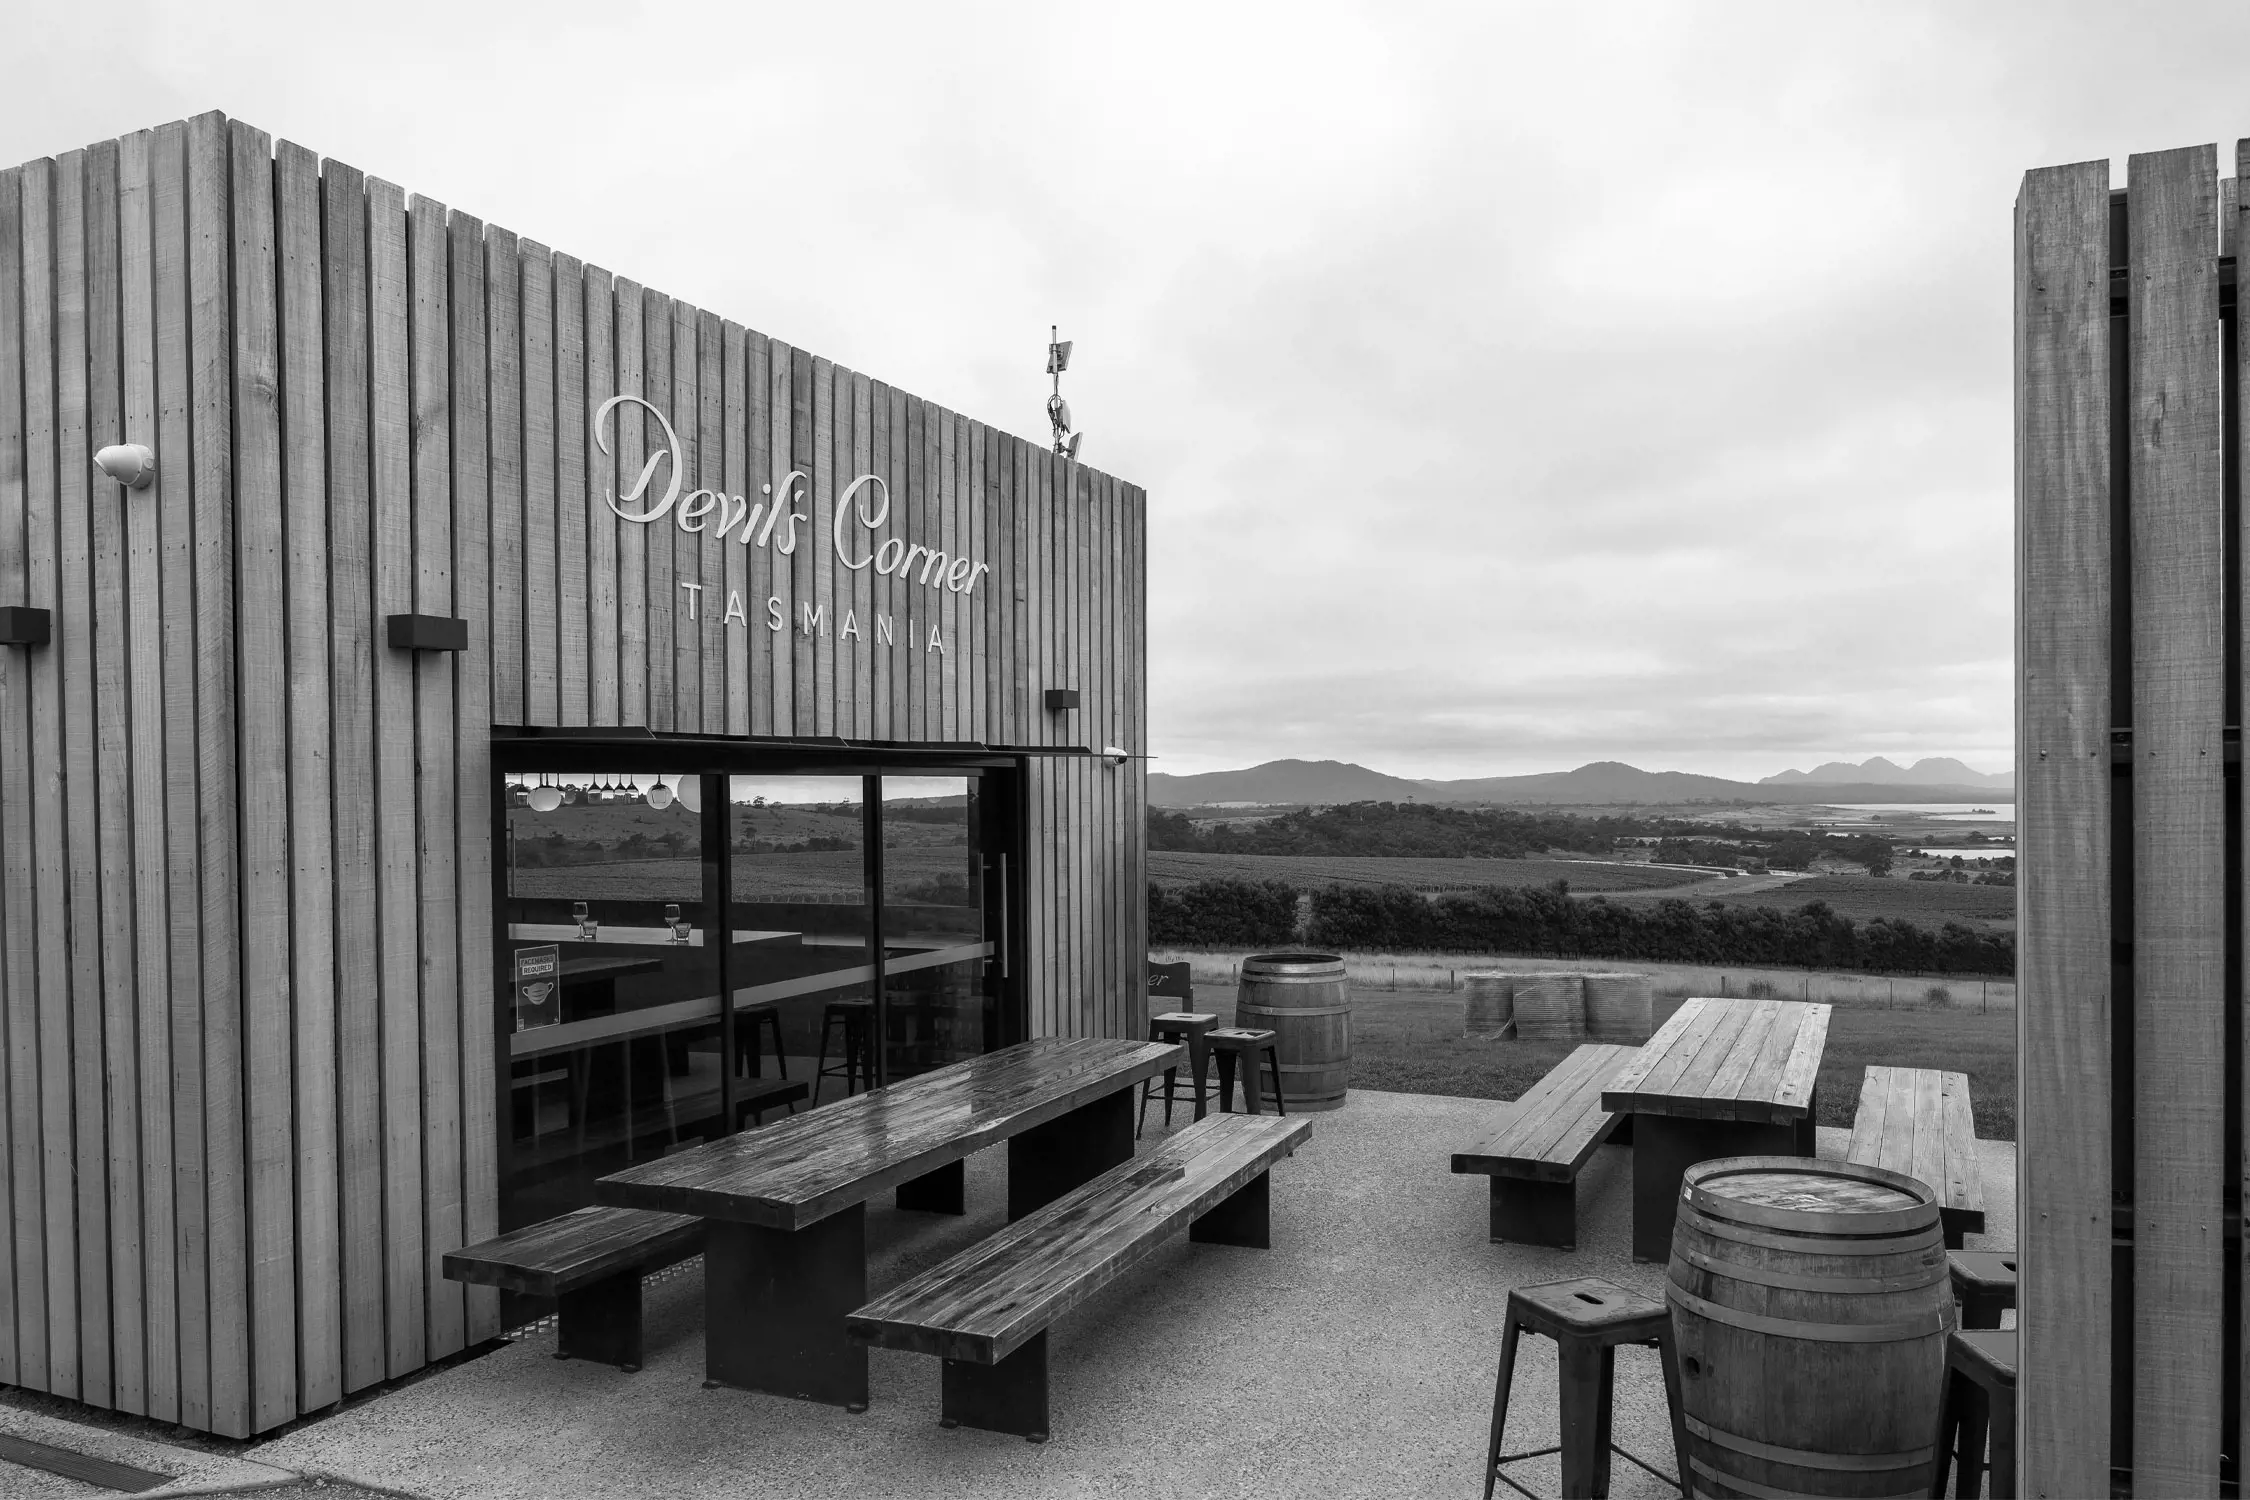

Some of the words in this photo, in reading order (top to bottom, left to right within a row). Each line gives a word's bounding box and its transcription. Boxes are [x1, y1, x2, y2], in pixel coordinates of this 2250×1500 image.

[594, 395, 807, 555] Devil's
[833, 474, 989, 595] Corner
[681, 582, 944, 654] TASMANIA
[523, 964, 552, 974] REQUIRED
